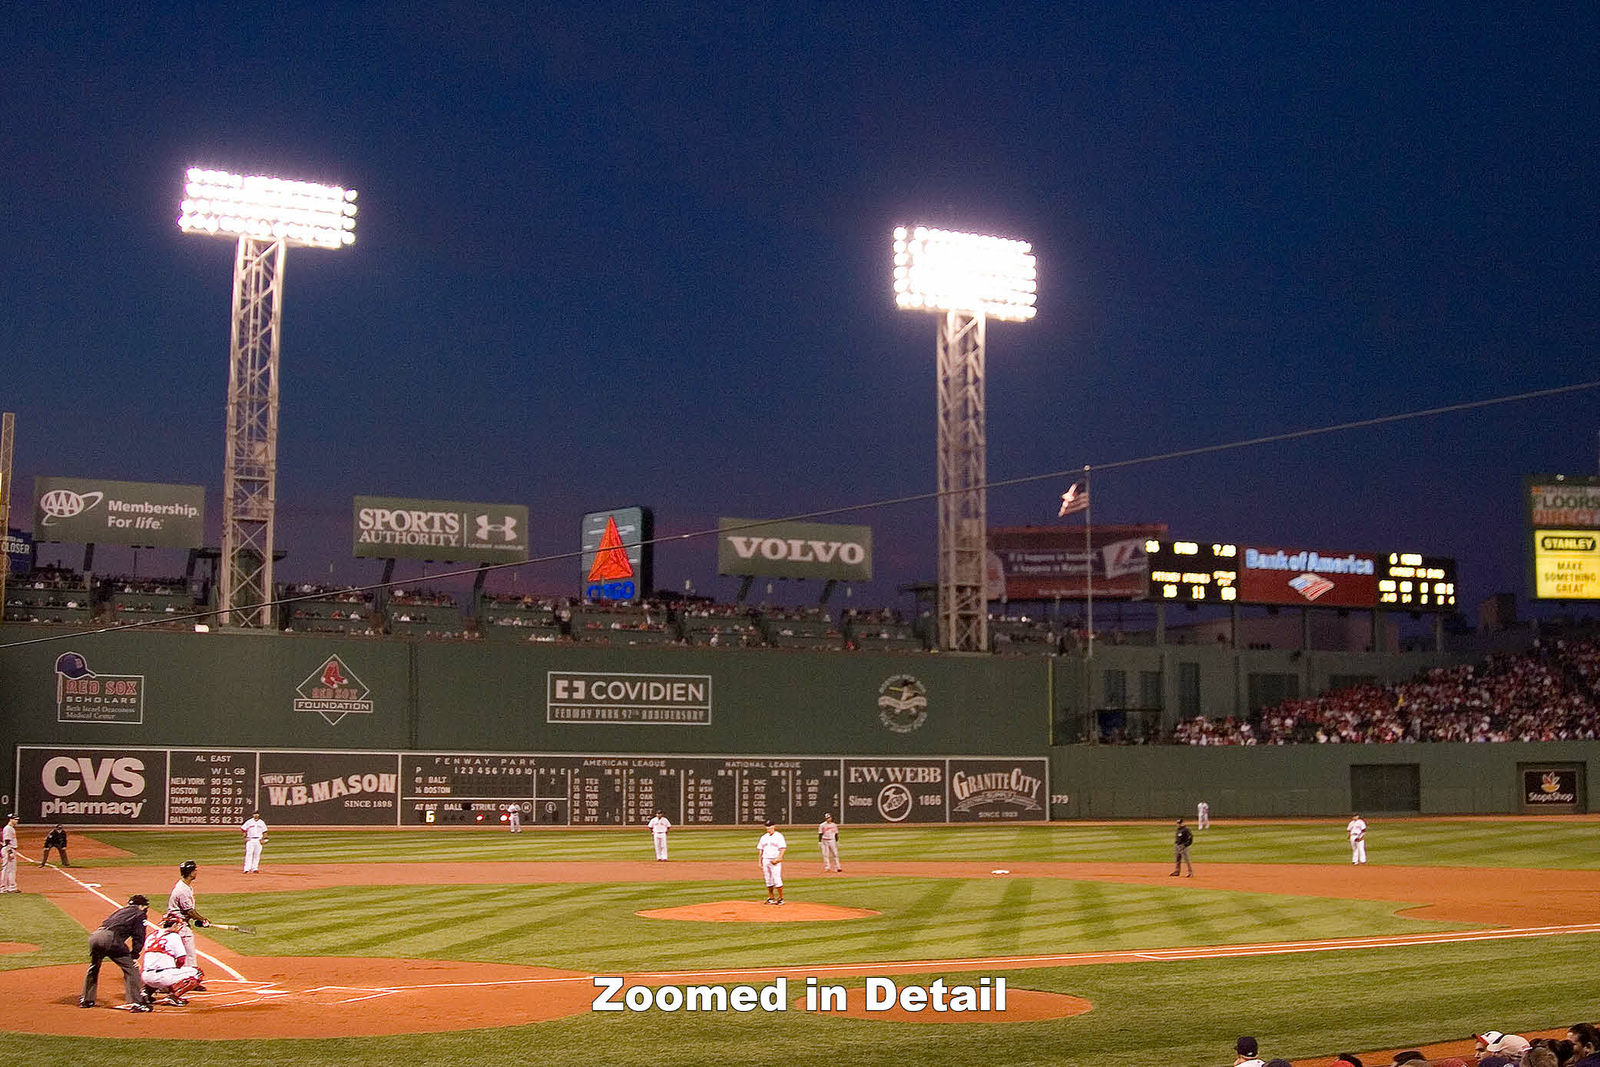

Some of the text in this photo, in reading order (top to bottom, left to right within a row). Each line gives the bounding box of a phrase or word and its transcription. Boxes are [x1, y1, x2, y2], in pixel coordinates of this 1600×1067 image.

[45, 490, 80, 515] AAA
[108, 500, 200, 518] Membership.
[107, 516, 163, 530] For life.
[359, 508, 459, 534] SPORTS
[359, 530, 459, 547] AUTHORITY
[1544, 538, 1593, 549] STANLEY
[727, 536, 865, 565] VOLVO
[1245, 548, 1288, 570] Bank
[1288, 551, 1307, 571] of
[1307, 552, 1374, 575] America
[1557, 562, 1582, 570] MAKE
[1545, 572, 1597, 582] SOMETHING
[1556, 583, 1584, 593] GREAT
[66, 680, 137, 695] RED SOX
[591, 681, 704, 702] COVIDIEN
[66, 696, 136, 704] SCHOLARS
[298, 701, 370, 710] FOUNDATION
[501, 758, 536, 766] PARK
[41, 756, 146, 797] CVS
[262, 775, 304, 785] WHO BUT
[428, 776, 447, 784] BALT
[849, 767, 942, 783] F.W. WEBB
[171, 777, 233, 785] NEW YORK 90 50
[952, 768, 1042, 801] GRANITE CITY
[170, 787, 199, 795] BOSTON
[236, 787, 243, 795] 9
[423, 786, 451, 794] BOSTON
[344, 800, 393, 808] SINCE 1898
[849, 795, 873, 807] Since
[41, 798, 143, 819] pharmacy
[170, 806, 244, 814] TORONTO 62 76 27
[414, 803, 424, 811] AT
[425, 803, 438, 811] BAT
[471, 803, 496, 811] STRIKE
[170, 816, 207, 824] BALTIMORE
[210, 816, 220, 824] 56
[233, 816, 244, 824] 33
